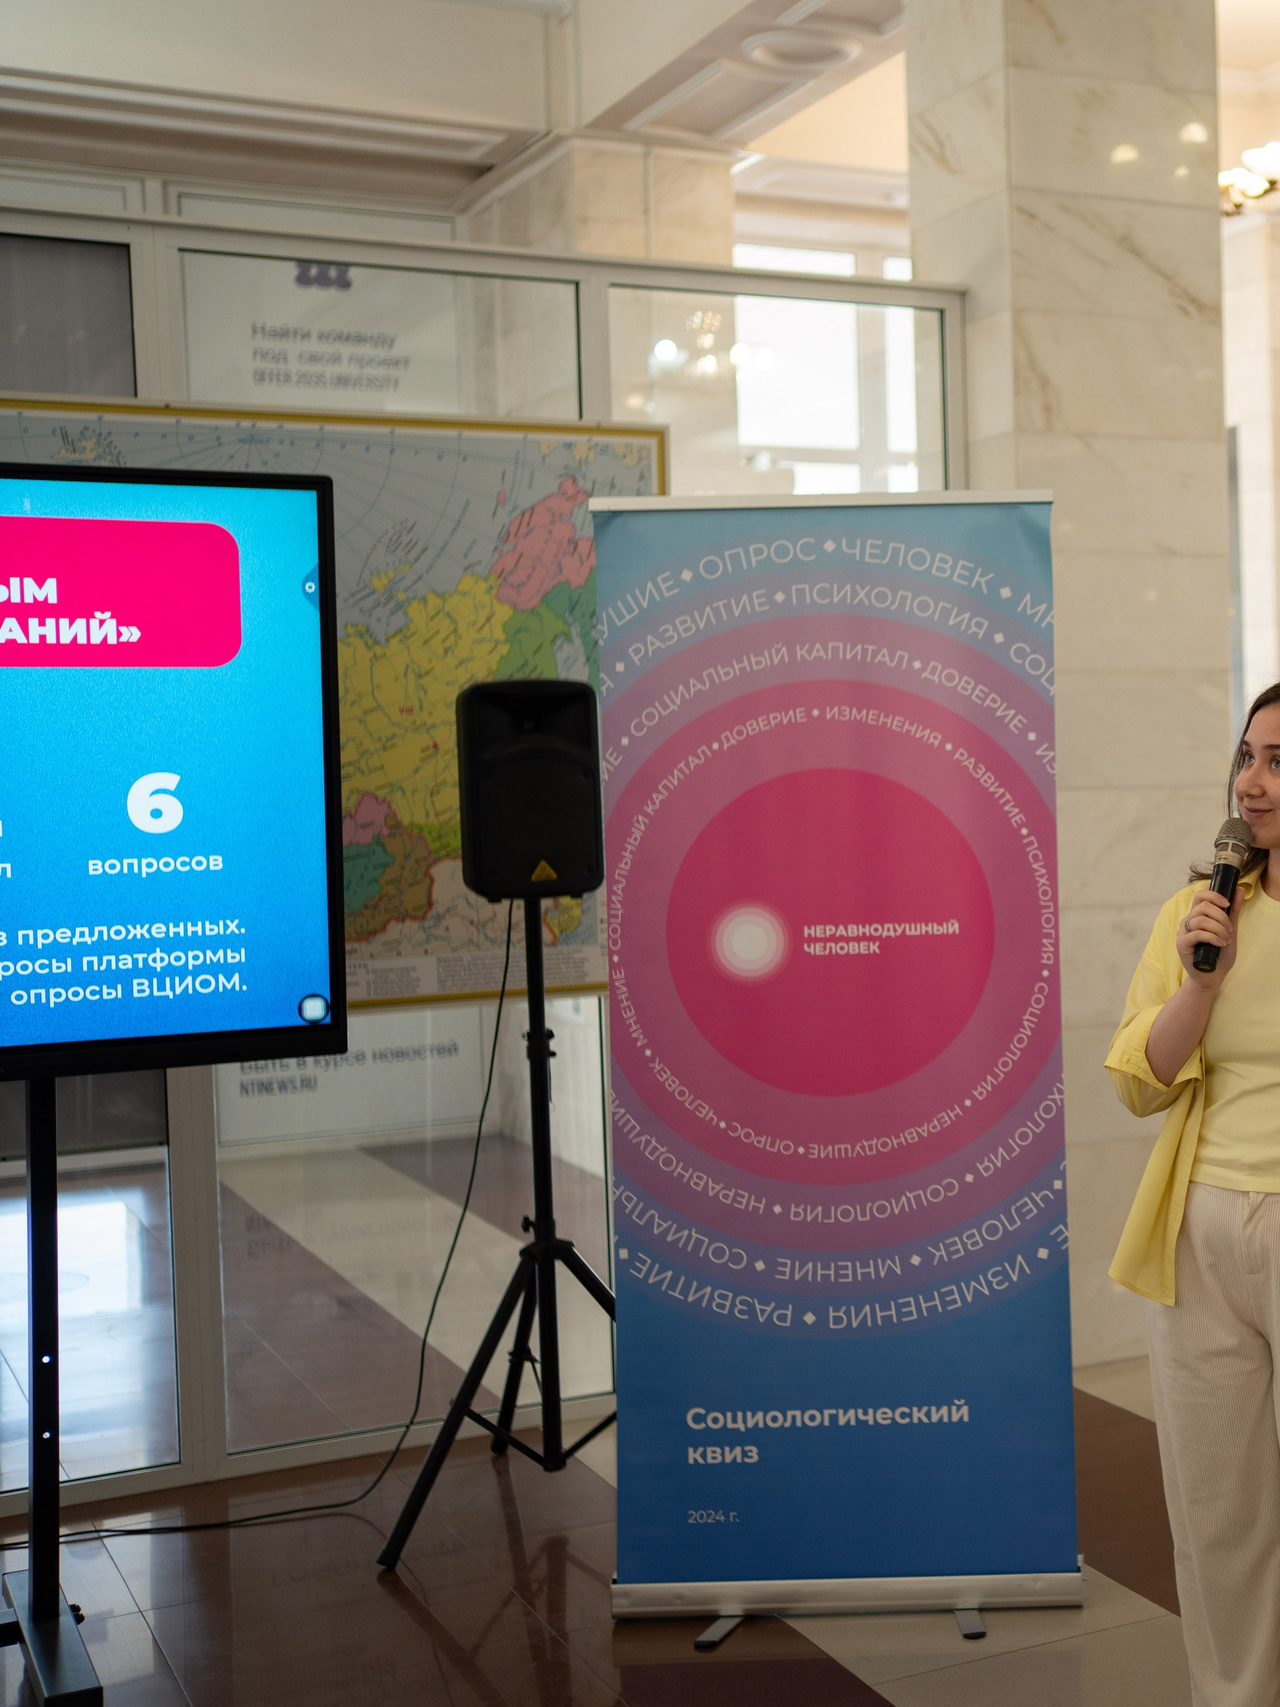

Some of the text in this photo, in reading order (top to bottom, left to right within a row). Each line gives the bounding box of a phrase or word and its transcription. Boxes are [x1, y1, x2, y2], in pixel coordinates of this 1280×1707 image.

[597, 570, 680, 646] УШИЕ
[699, 537, 817, 579] ОПРОС
[842, 537, 995, 594] ЧЕЛОВЕК
[628, 589, 769, 666] РАЗВИТИЕ
[791, 582, 989, 639] ПСИХОЛОГИЯ
[630, 642, 788, 737] СОЦИАЛЬНЫЙ
[796, 641, 909, 670] КАПИТАЛ
[921, 660, 1028, 735] ДОВЕРИЕ
[126, 771, 184, 834] 6
[88, 854, 223, 878] вопросов
[17, 919, 246, 949] предложенных.
[609, 705, 1056, 1160] МНЕНИЕ СОЦИАЛЬНЫЙ КАПИТАЛ ДОВЕРИЕ ИЗМЕНЕНИЯ РАЗВИТИЕ ПСИХОЛОГИЯ СОЦИОЛОГИЯ НЕРАВНОДУШИЕ ОПРОС ЧЕЛОВЕК
[803, 918, 960, 939] НЕРАВНОДУШНЫЙ
[803, 941, 881, 956] ЧЕЛОВЕК
[82, 947, 246, 973] платформы
[10, 972, 248, 1008] опросы ВЦИОМ.
[611, 1089, 766, 1215] НЕРАВНОДУШИ
[790, 1178, 959, 1224] СОЦИОЛОГИЯ
[927, 1189, 1055, 1266] ЧЕЛОВЕК
[629, 1251, 793, 1327] РАЗВИТИЕ
[775, 1254, 902, 1283] МНЕНИЕ
[829, 1254, 1031, 1329] ИЗМЕНЕНИЯ
[686, 1399, 970, 1432] Социологический
[687, 1445, 760, 1465] квиз
[687, 1510, 740, 1525] 2024 г.
